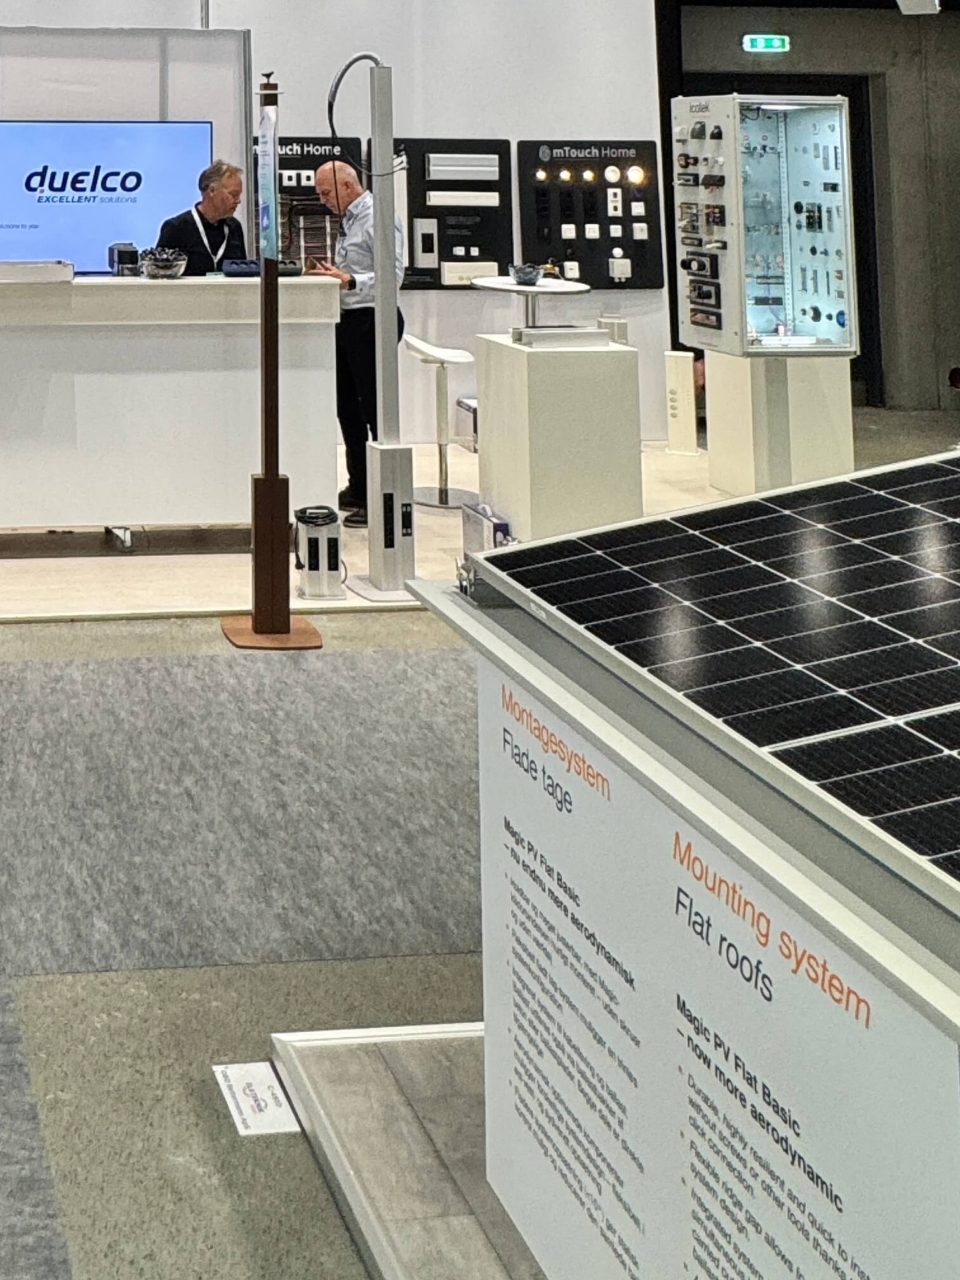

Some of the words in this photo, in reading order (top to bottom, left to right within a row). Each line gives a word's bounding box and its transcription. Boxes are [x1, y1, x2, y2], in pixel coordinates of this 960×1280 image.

[24, 165, 142, 193] duelco
[303, 143, 341, 155] Home
[552, 146, 600, 158] mTouch
[601, 147, 636, 158] Home
[37, 195, 98, 204] EXCELLENT
[99, 196, 137, 204] solutions
[501, 684, 610, 802] Montagesystem
[502, 727, 538, 781] Flade
[541, 765, 572, 813] tage
[503, 815, 525, 849] Magic
[526, 840, 538, 861] PV
[539, 853, 555, 881] Flat
[555, 870, 580, 907] Basic
[547, 886, 569, 918] mere
[570, 912, 635, 991] aerodynamisk
[672, 832, 770, 947] Mounting
[778, 931, 870, 1027] system
[674, 886, 712, 946] Flat
[717, 934, 772, 1002] roofs
[676, 993, 710, 1042] Magic
[713, 1031, 730, 1062] PV
[733, 1053, 758, 1094] Flat
[761, 1082, 800, 1137] Basic
[686, 1034, 711, 1069] now
[714, 1064, 747, 1109] more
[750, 1103, 842, 1212] aerodynamic
[687, 1114, 706, 1141] click
[687, 1095, 716, 1134] without
[717, 1129, 747, 1169] screws
[748, 1165, 759, 1181] or
[760, 1179, 785, 1211] other
[786, 1206, 810, 1242] tools
[689, 1161, 718, 1201] system
[689, 1139, 720, 1184] Flexible
[720, 1180, 743, 1212] ridge
[744, 1208, 762, 1235] gap
[763, 1231, 793, 1273] allows
[690, 1187, 731, 1245] Integrated
[722, 1113, 747, 1150] highly
[749, 1146, 785, 1192] resilient
[786, 1187, 806, 1215] and
[806, 1211, 835, 1248] quick
[837, 1242, 847, 1262] to
